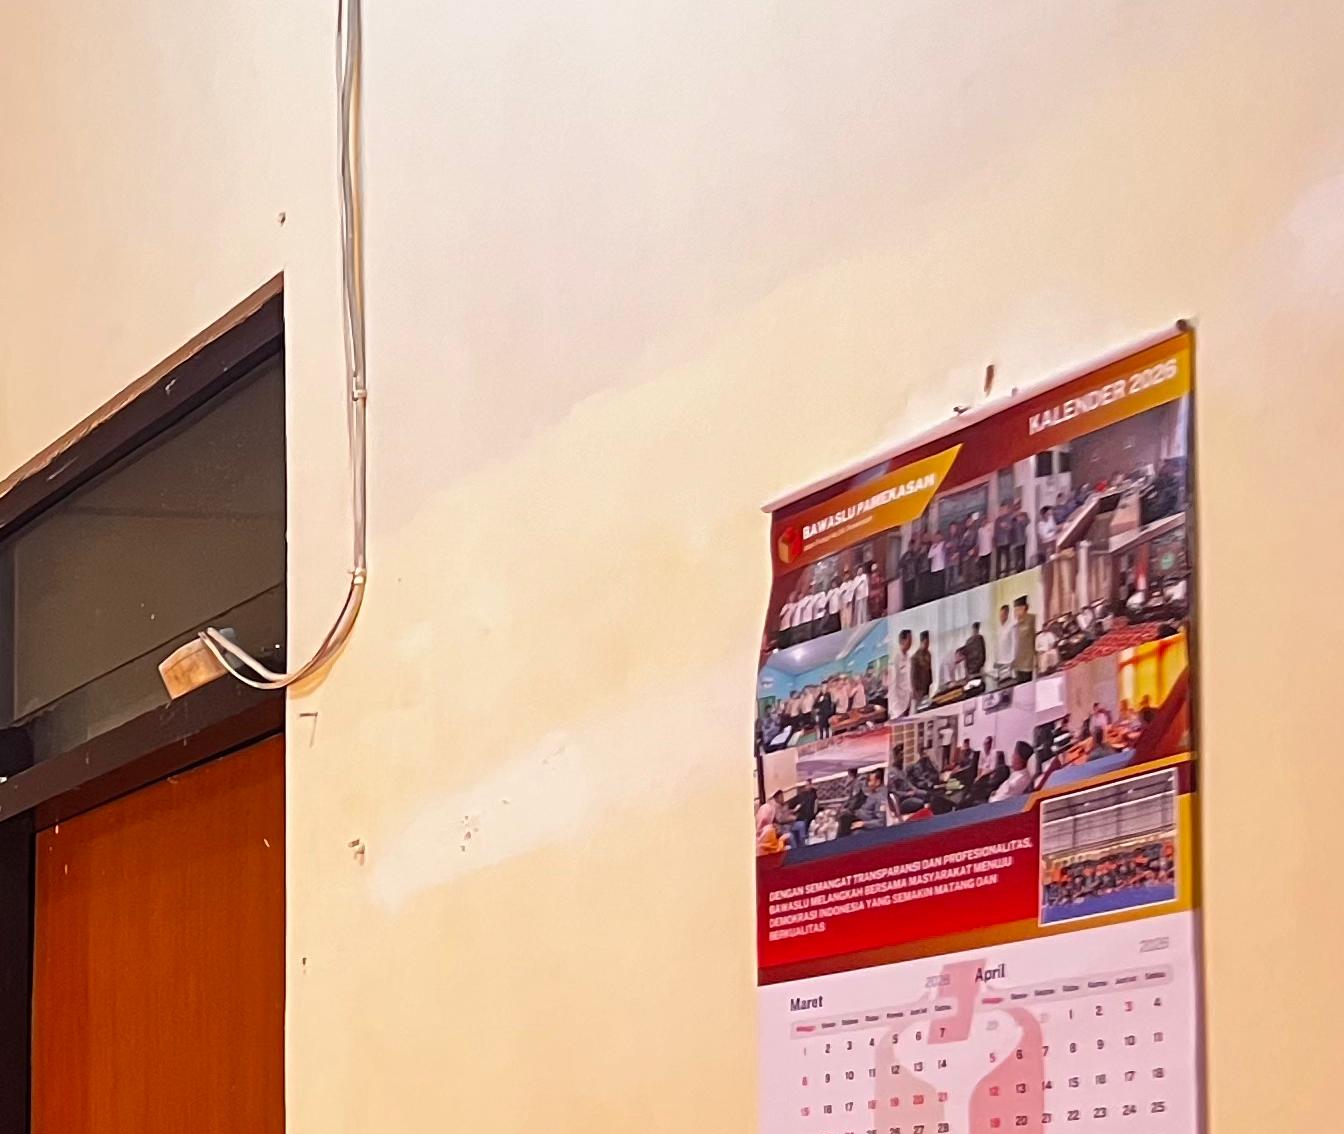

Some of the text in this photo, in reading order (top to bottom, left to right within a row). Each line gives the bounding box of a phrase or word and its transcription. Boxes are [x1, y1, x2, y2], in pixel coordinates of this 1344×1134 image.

[1029, 380, 1126, 435] KALENDER
[803, 506, 856, 540] BAWASLU
[805, 875, 852, 894] SEMANGAT
[853, 861, 921, 884] TRANSPARANSI
[922, 857, 942, 870] DAN
[908, 864, 973, 886] MASYARAKAT
[933, 879, 975, 895] MATANG
[790, 996, 823, 1011] Maret
[975, 963, 1006, 983] April
[989, 1052, 996, 1063] 5
[1016, 1049, 1023, 1060] 6
[1042, 1046, 1049, 1057] 7
[1069, 1042, 1077, 1053] 8
[1097, 1039, 1104, 1050] 9
[1124, 1035, 1136, 1046] 10
[825, 1073, 831, 1083] 9
[845, 1070, 854, 1080] 10
[868, 1068, 876, 1077] 11
[891, 1065, 900, 1075] 12
[914, 1062, 923, 1072] 13
[937, 1059, 947, 1069] 14
[989, 1086, 999, 1097] 12
[1016, 1083, 1026, 1094] 13
[1042, 1081, 1052, 1091] 14
[1068, 1077, 1080, 1088] 15
[1124, 1070, 1136, 1082] 17
[845, 1102, 854, 1112] 17
[913, 1094, 924, 1105] 20
[938, 1092, 948, 1102] 21
[1016, 1115, 1028, 1126] 20
[1041, 1113, 1052, 1124] 21
[1067, 1110, 1080, 1121] 22
[1093, 1107, 1107, 1118] 23
[1122, 1105, 1137, 1115] 24
[1151, 1101, 1166, 1113] 25
[937, 1122, 949, 1133] 28
